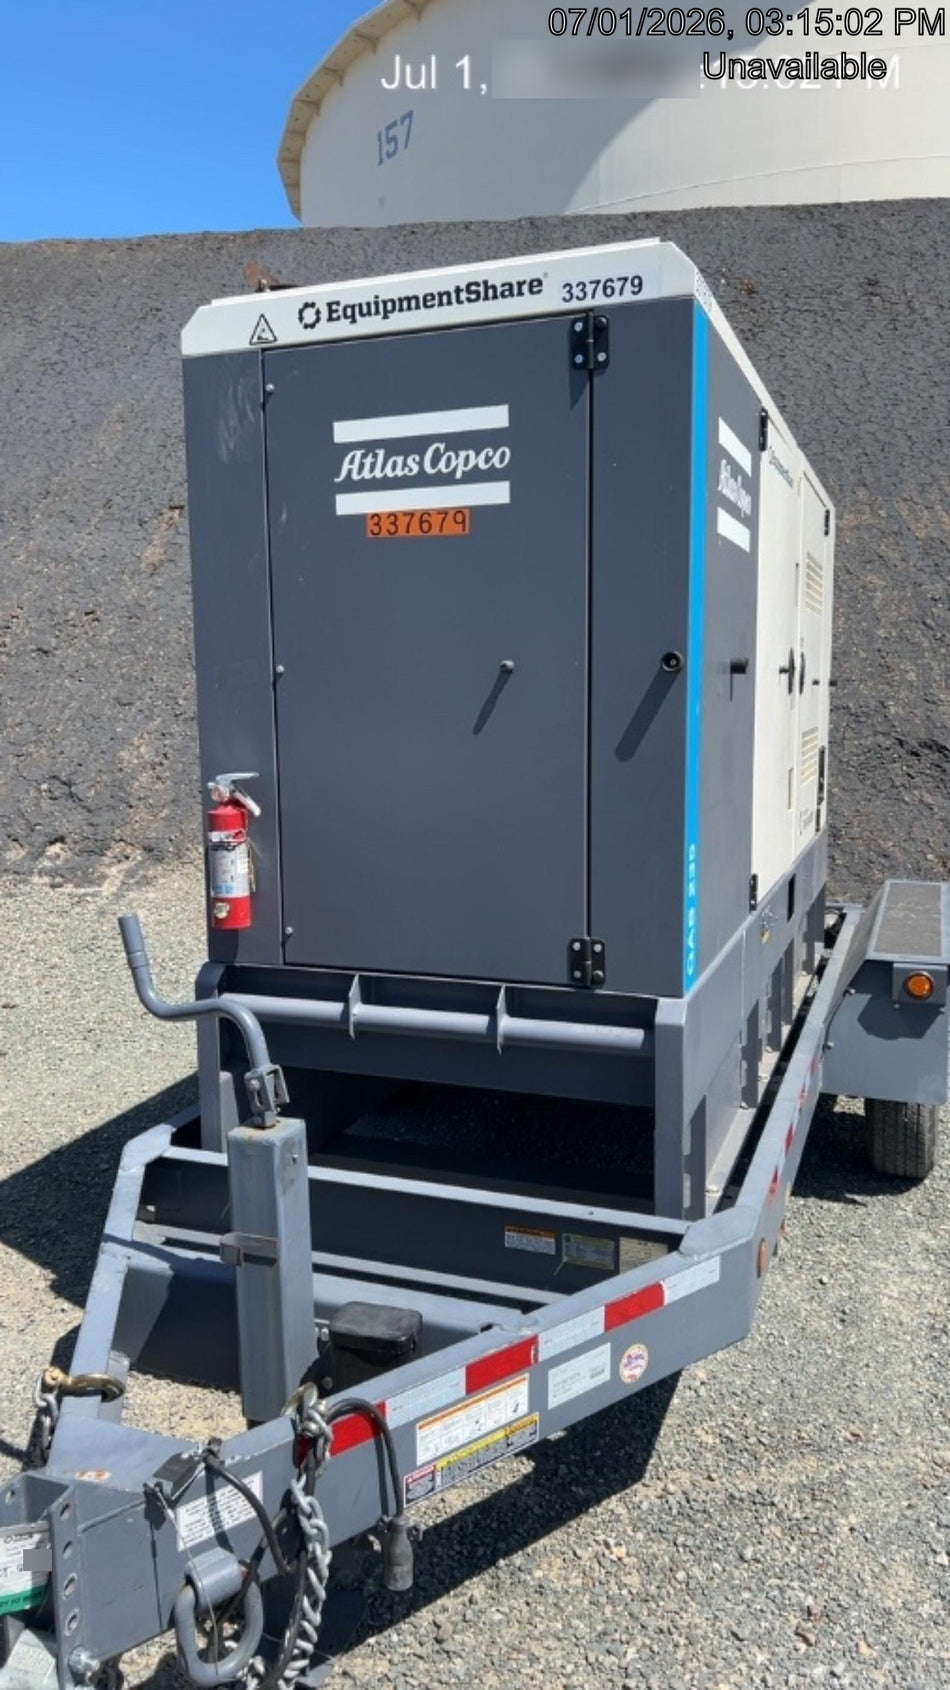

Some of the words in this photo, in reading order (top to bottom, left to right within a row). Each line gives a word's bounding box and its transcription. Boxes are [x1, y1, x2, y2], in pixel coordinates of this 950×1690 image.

[377, 109, 414, 166] 157
[325, 276, 544, 324] EquipmentShare
[562, 275, 644, 303] 337679
[334, 449, 420, 483] Atlas
[423, 442, 511, 480] Copco
[369, 510, 467, 536] 337679
